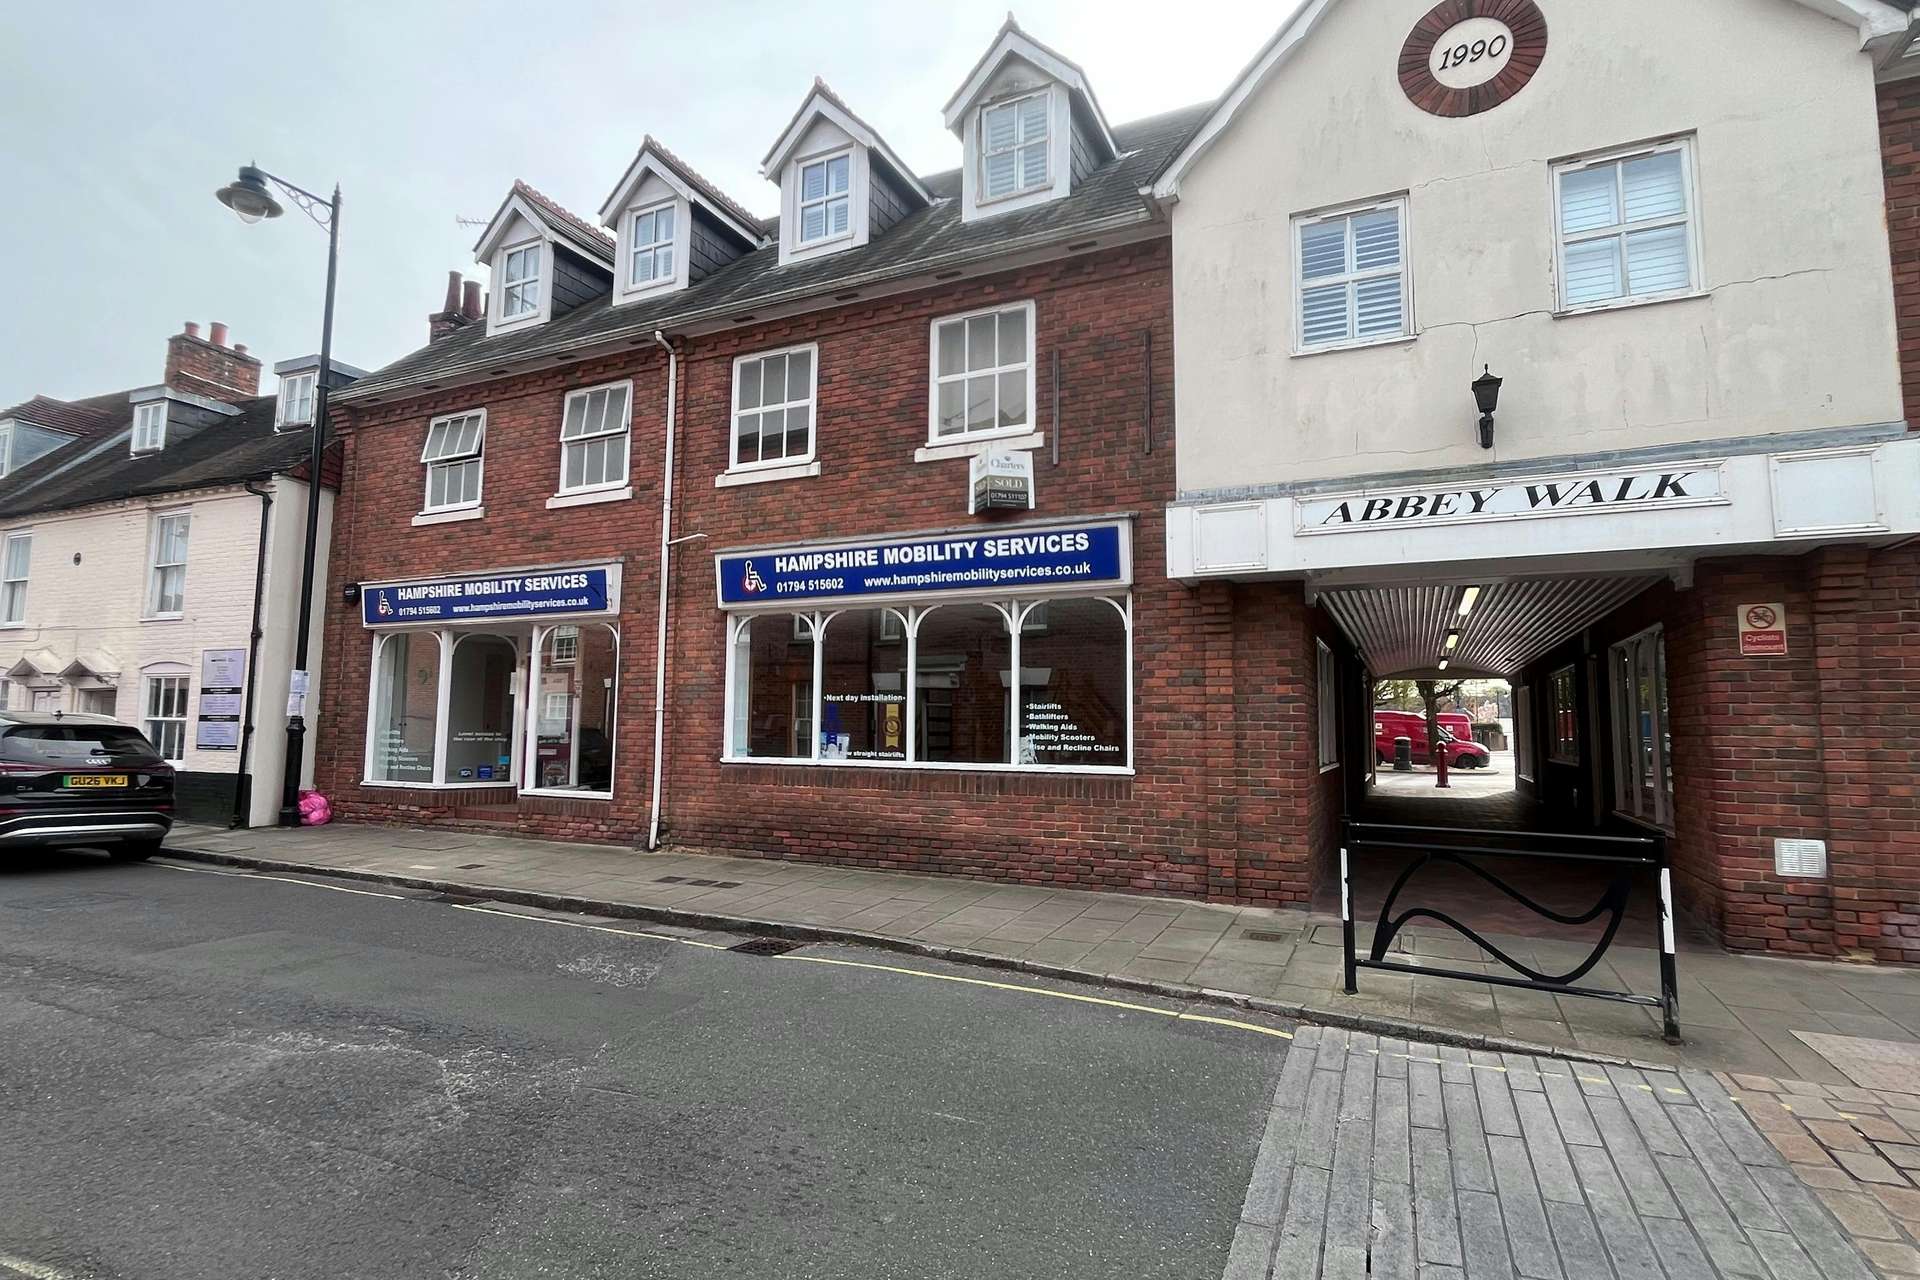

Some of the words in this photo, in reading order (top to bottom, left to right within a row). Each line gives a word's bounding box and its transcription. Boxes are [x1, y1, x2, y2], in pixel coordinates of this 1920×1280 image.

[1438, 34, 1507, 71] 1990
[995, 479, 1023, 488] SOLD
[1320, 487, 1502, 525] ABBEY
[1519, 471, 1698, 512] WALK
[774, 550, 879, 573] HAMPSHIRE
[883, 541, 977, 565] MOBILITY
[983, 533, 1090, 558] SERVICES
[863, 561, 1091, 587] www.hampshiremobilityservices.co.uk
[397, 583, 462, 601] HAMPSHIRE
[464, 579, 522, 596] MOBILITY
[524, 573, 588, 592] SERVICES
[776, 580, 807, 593] 01794
[808, 578, 844, 591] 515602
[452, 596, 589, 613] www.hampshiremobilityservices.co.uk
[398, 606, 417, 616] 01794
[1745, 634, 1780, 642] Cyclists
[826, 693, 844, 701] Next
[845, 693, 859, 703] day
[860, 693, 903, 701] installation
[1028, 723, 1059, 731] Walking
[1093, 744, 1120, 752] Chairs
[853, 750, 878, 758] straight
[71, 776, 101, 786] GU26
[105, 775, 126, 785] VKJ
